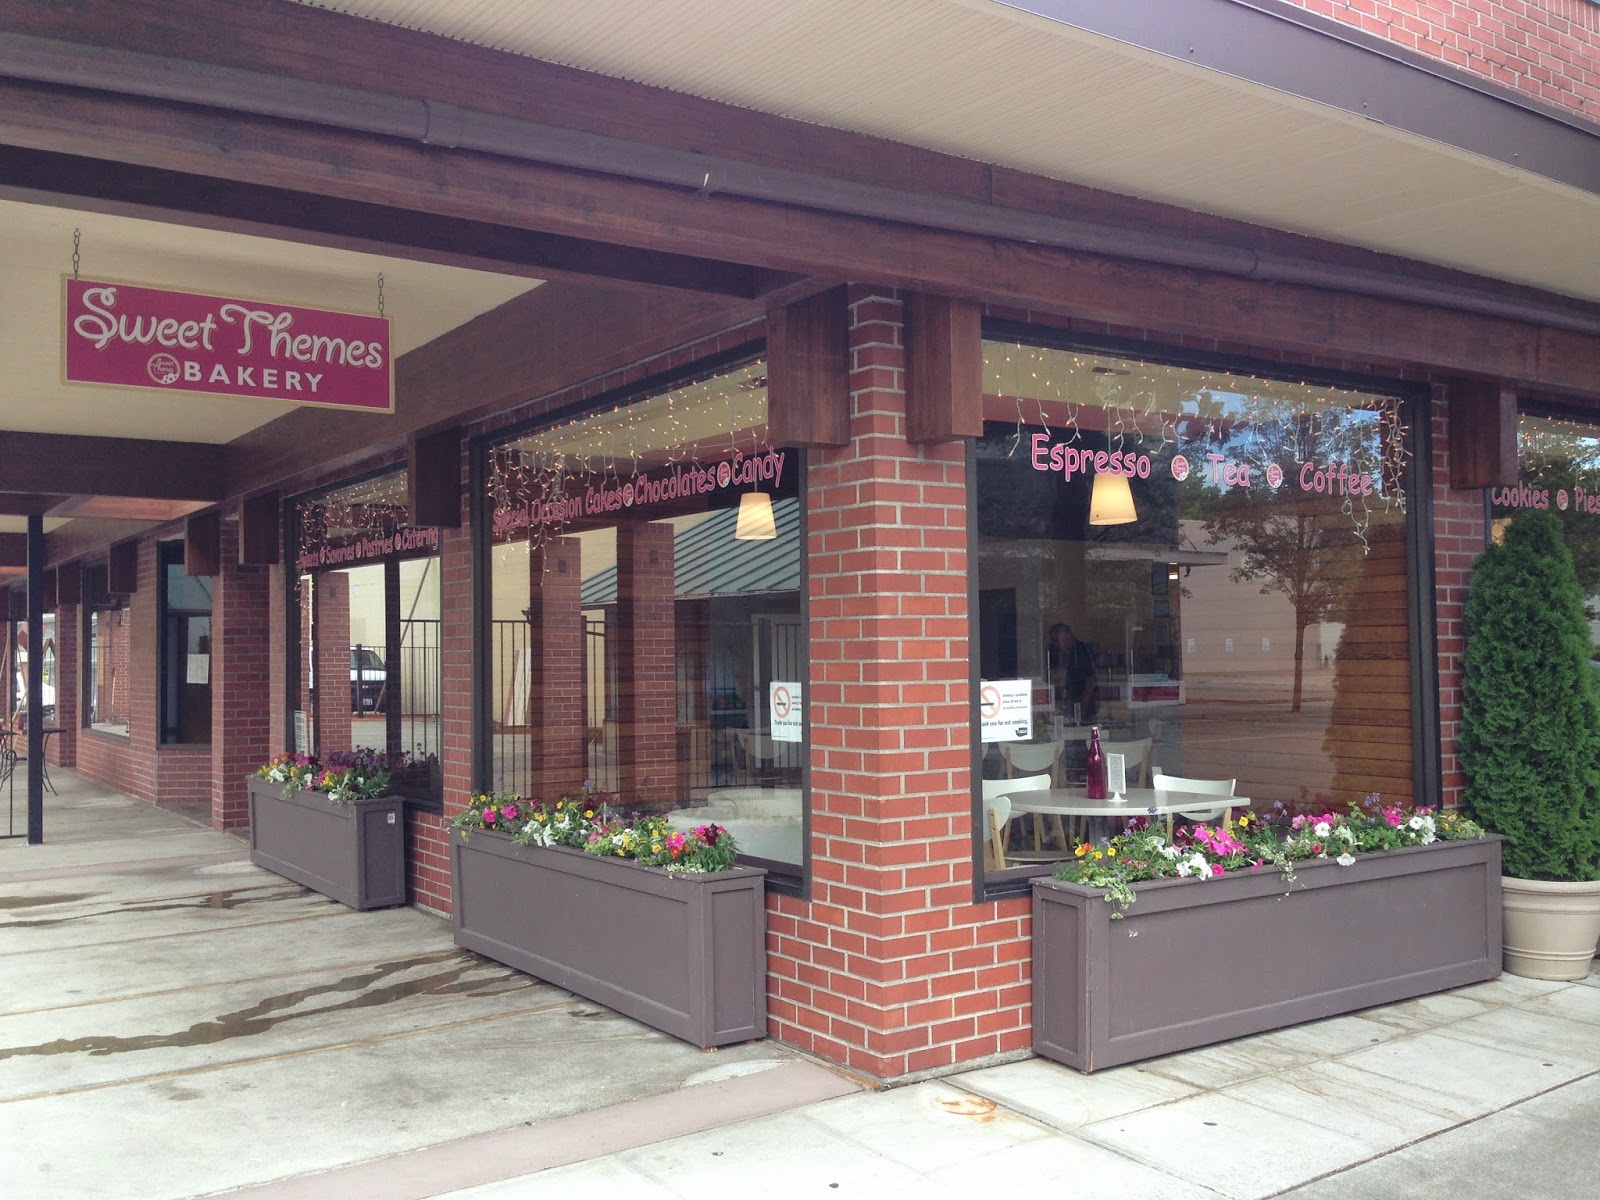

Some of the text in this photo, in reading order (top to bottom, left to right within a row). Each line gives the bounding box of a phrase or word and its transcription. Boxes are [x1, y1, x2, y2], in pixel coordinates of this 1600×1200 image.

[74, 287, 384, 369] Sweet Themes
[184, 361, 323, 393] BAKERY
[531, 493, 582, 524] Occasion
[585, 483, 622, 515] Cakes
[634, 464, 716, 504] Chocolates
[732, 446, 785, 488] Candy
[1030, 433, 1373, 496] Espresso Tea Coffee
[1491, 479, 1549, 510] Cookies
[362, 536, 393, 558] Pastries
[402, 527, 439, 551] Catering
